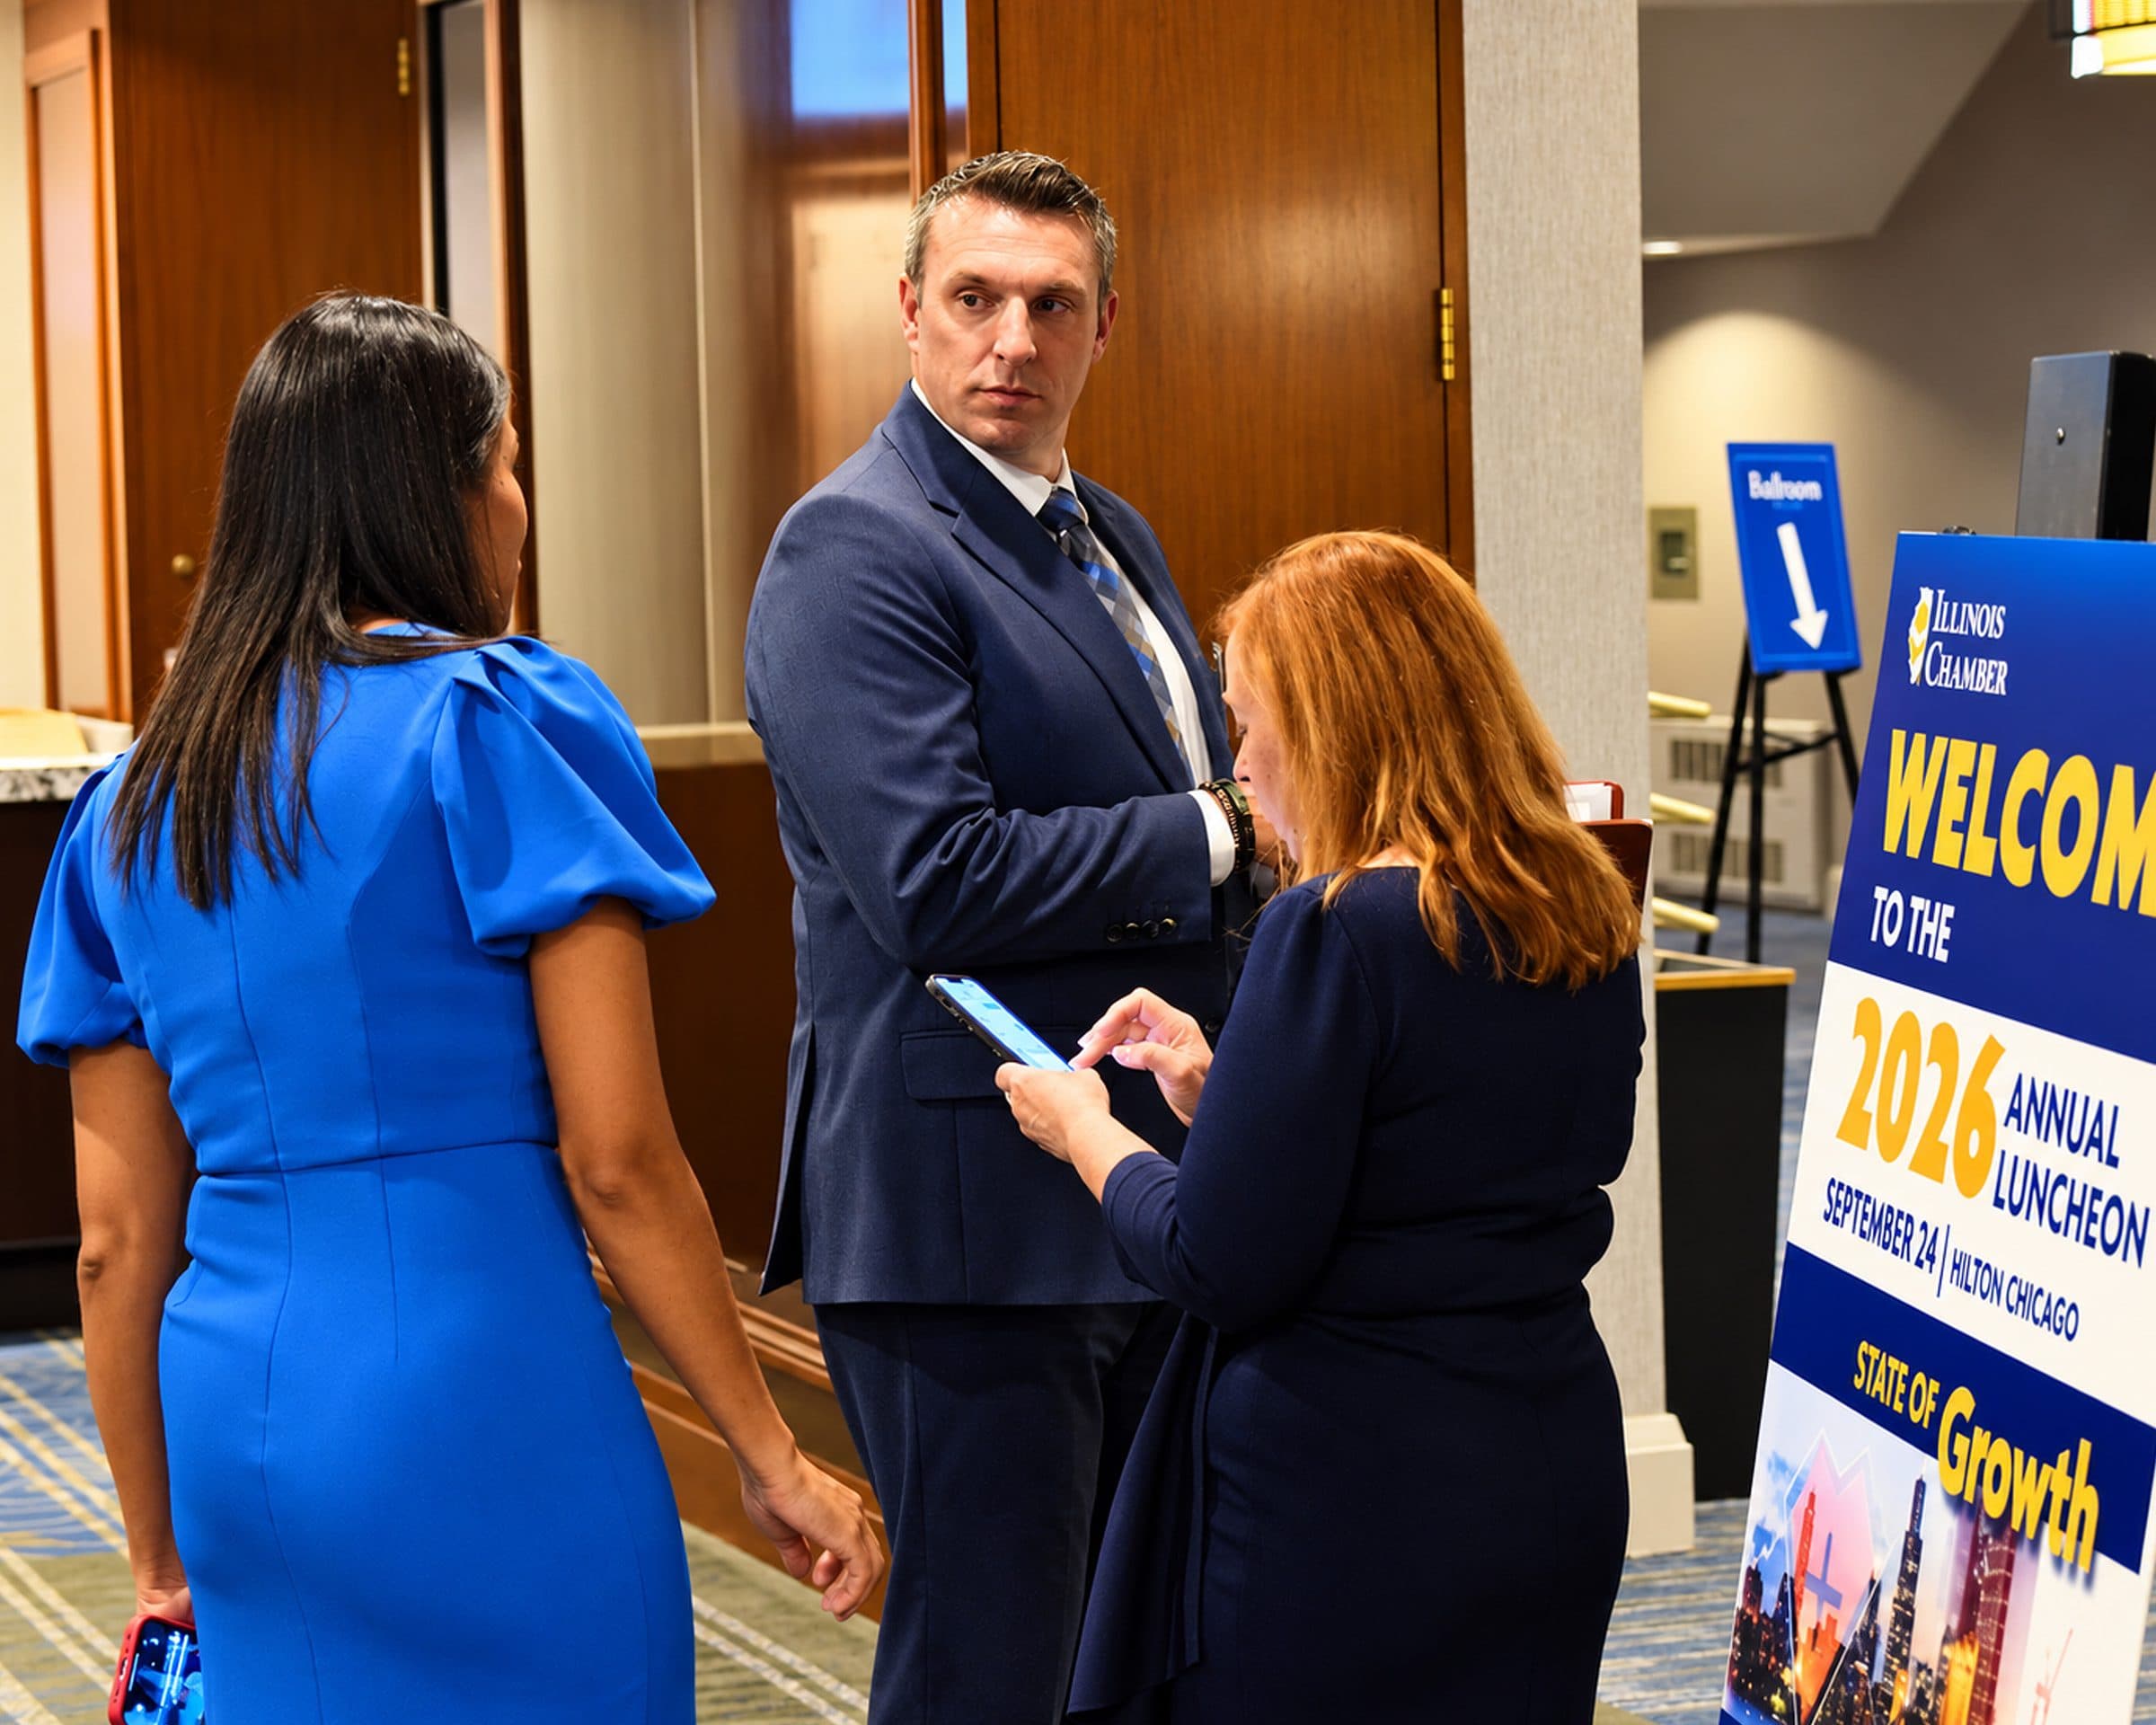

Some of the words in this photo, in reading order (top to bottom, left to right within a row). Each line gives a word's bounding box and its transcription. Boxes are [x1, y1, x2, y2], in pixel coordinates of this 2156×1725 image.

[1748, 470, 1823, 500] Ballroom
[1870, 885, 1904, 947] TO
[1907, 895, 1956, 963] THE
[1835, 996, 2006, 1199] 2026
[2003, 1073, 2120, 1169] ANNUAL
[1823, 1177, 1914, 1262] SEPTEMBER
[1913, 1220, 1940, 1274] 24
[1949, 1248, 2005, 1306] HILTON
[2005, 1275, 2080, 1342] CHICAGO
[1993, 1149, 2151, 1269] LUNCHEON
[1853, 1340, 1909, 1414] STATE
[1908, 1371, 1940, 1429] OF
[1937, 1386, 2099, 1573] Growth
